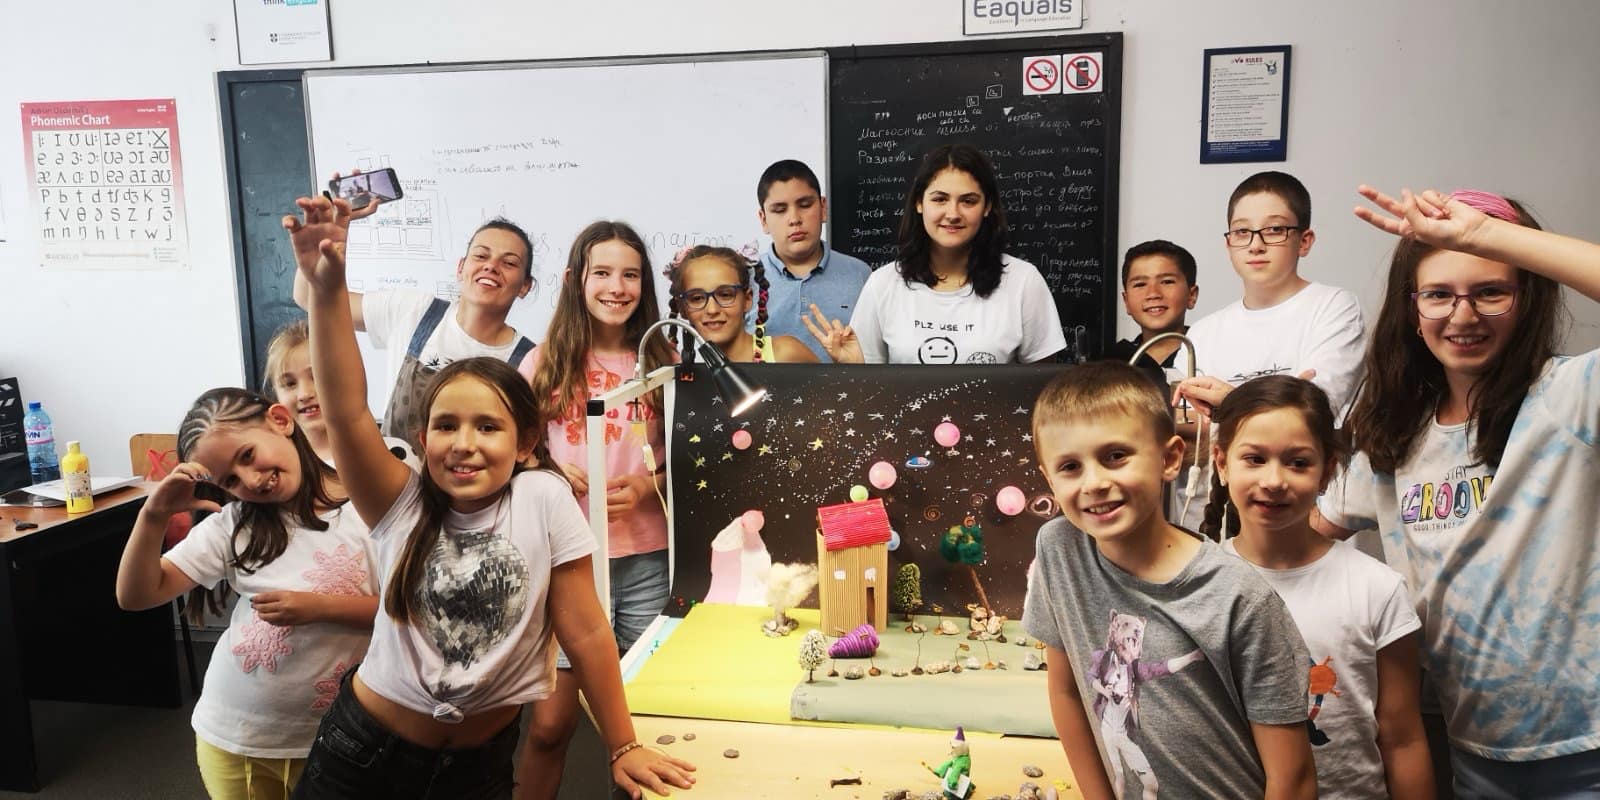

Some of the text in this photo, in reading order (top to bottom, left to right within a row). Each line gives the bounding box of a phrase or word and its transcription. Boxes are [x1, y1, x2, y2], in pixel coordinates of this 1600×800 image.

[31, 114, 110, 126] Phonemic Chart
[914, 320, 934, 330] PLZ
[965, 324, 975, 332] IT
